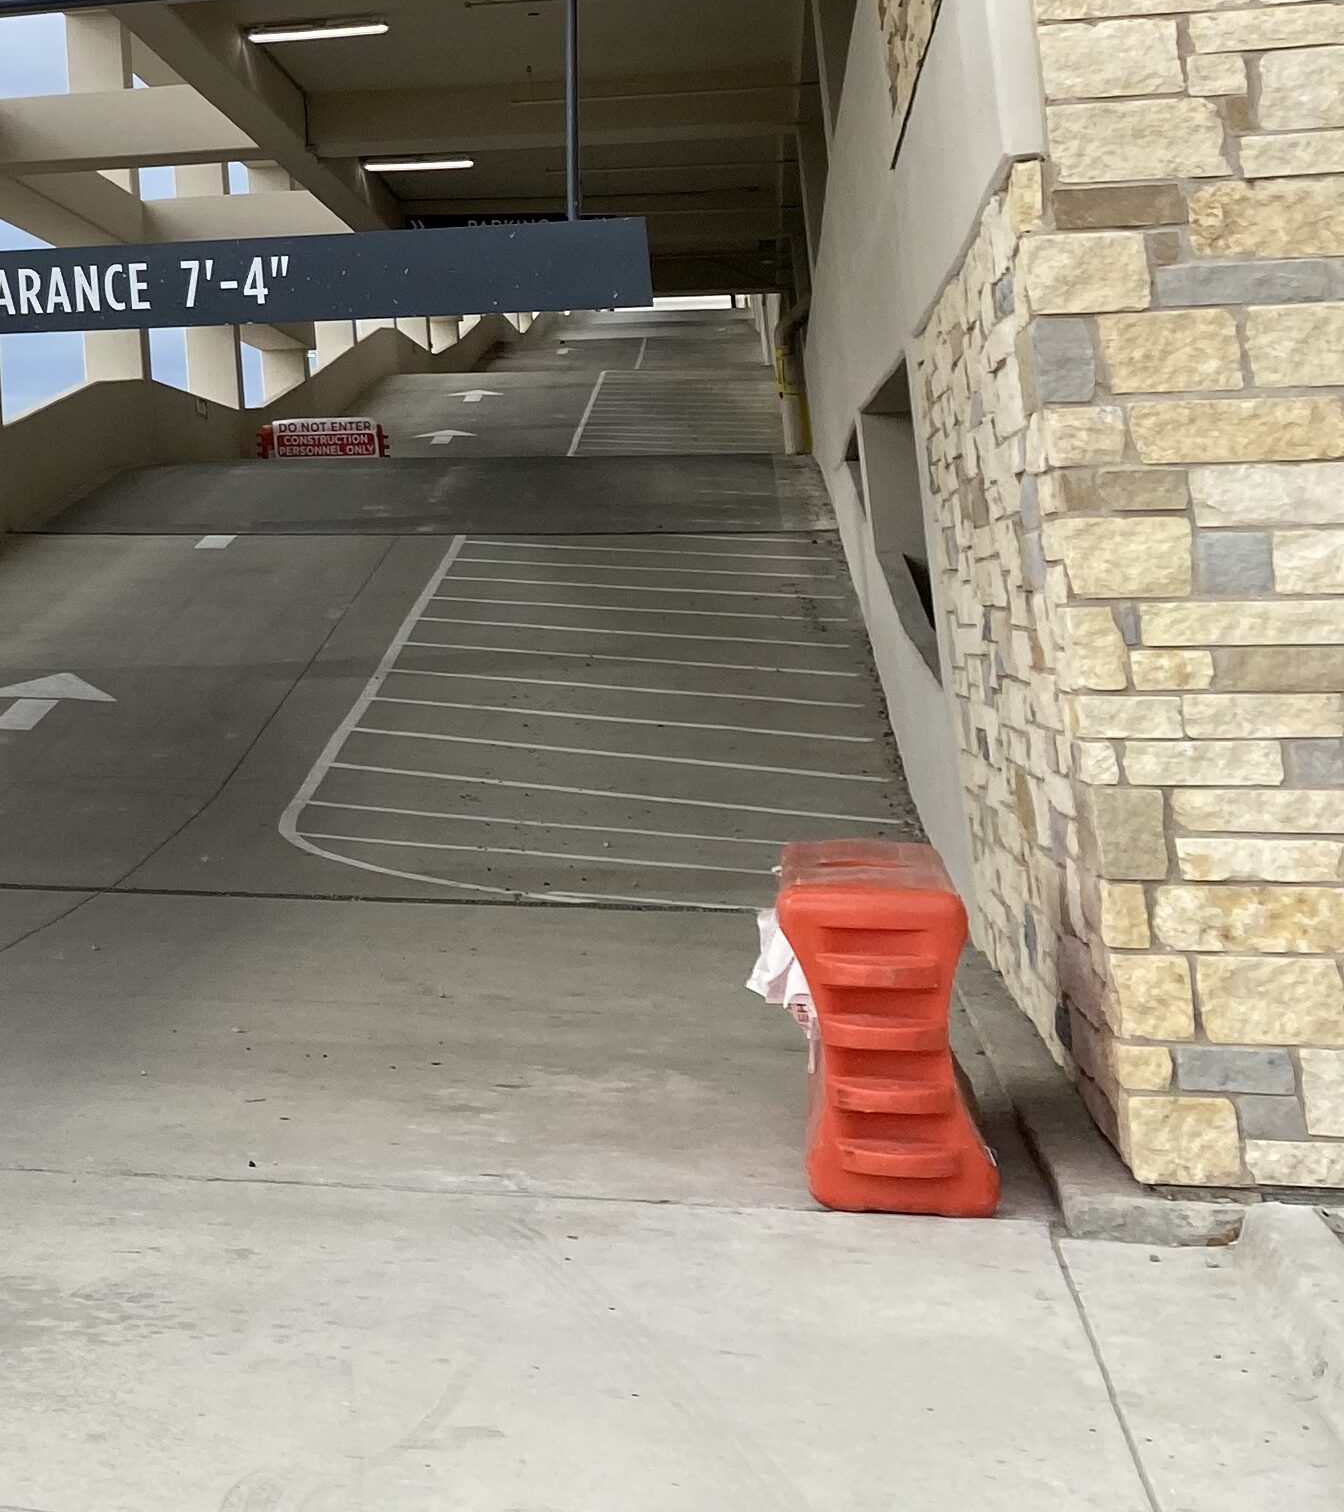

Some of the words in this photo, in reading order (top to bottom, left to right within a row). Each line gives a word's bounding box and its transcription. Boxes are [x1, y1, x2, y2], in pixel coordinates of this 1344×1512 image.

[179, 255, 290, 309] 7'-4"
[278, 422, 297, 434] DO
[301, 421, 328, 433] NOT
[331, 420, 372, 433] ENTER
[283, 434, 369, 446] CONSTRUCTION
[278, 445, 344, 457] PERSONNEL
[346, 444, 374, 455] ONLY
